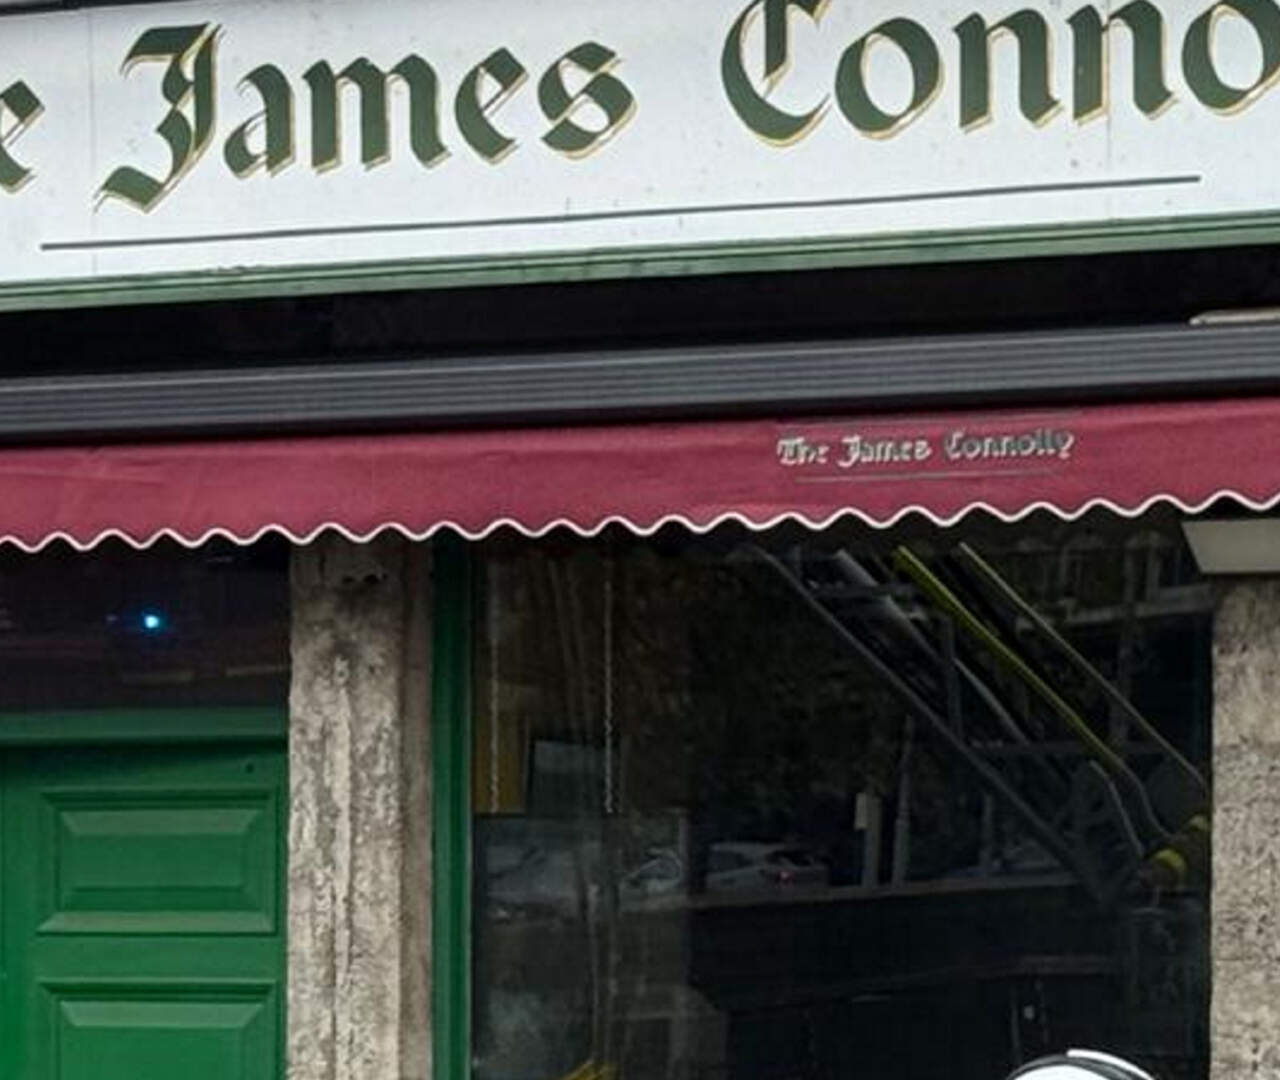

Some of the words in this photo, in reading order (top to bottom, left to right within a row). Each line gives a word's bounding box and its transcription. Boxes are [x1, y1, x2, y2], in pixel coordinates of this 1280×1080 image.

[92, 21, 640, 214] James
[776, 435, 827, 467] The
[836, 433, 932, 468] James
[943, 427, 1075, 461] Connolly
